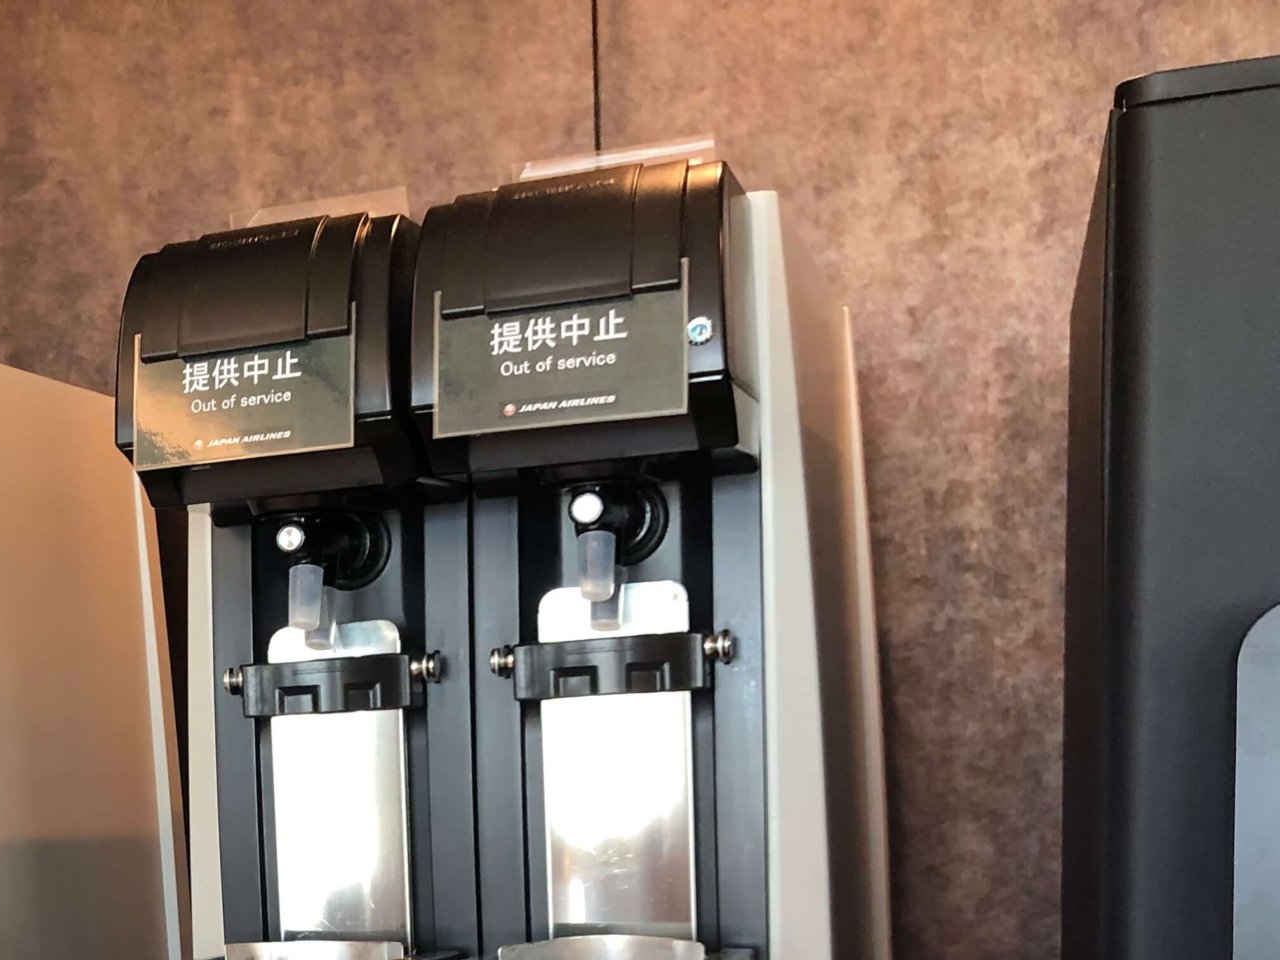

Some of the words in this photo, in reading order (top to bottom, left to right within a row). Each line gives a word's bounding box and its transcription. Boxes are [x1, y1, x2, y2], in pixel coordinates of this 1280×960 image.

[490, 308, 628, 356] 提供中止
[182, 350, 302, 394] 提供中止
[500, 360, 531, 376] Out
[535, 355, 553, 372] of
[557, 351, 617, 370] service
[191, 398, 217, 413] Out
[221, 394, 237, 409] of
[240, 389, 292, 407] service
[518, 401, 558, 413] JAPAN
[558, 394, 617, 408] AIRLINES
[206, 436, 240, 448] JAPAN
[241, 430, 292, 443] AIRLINES
